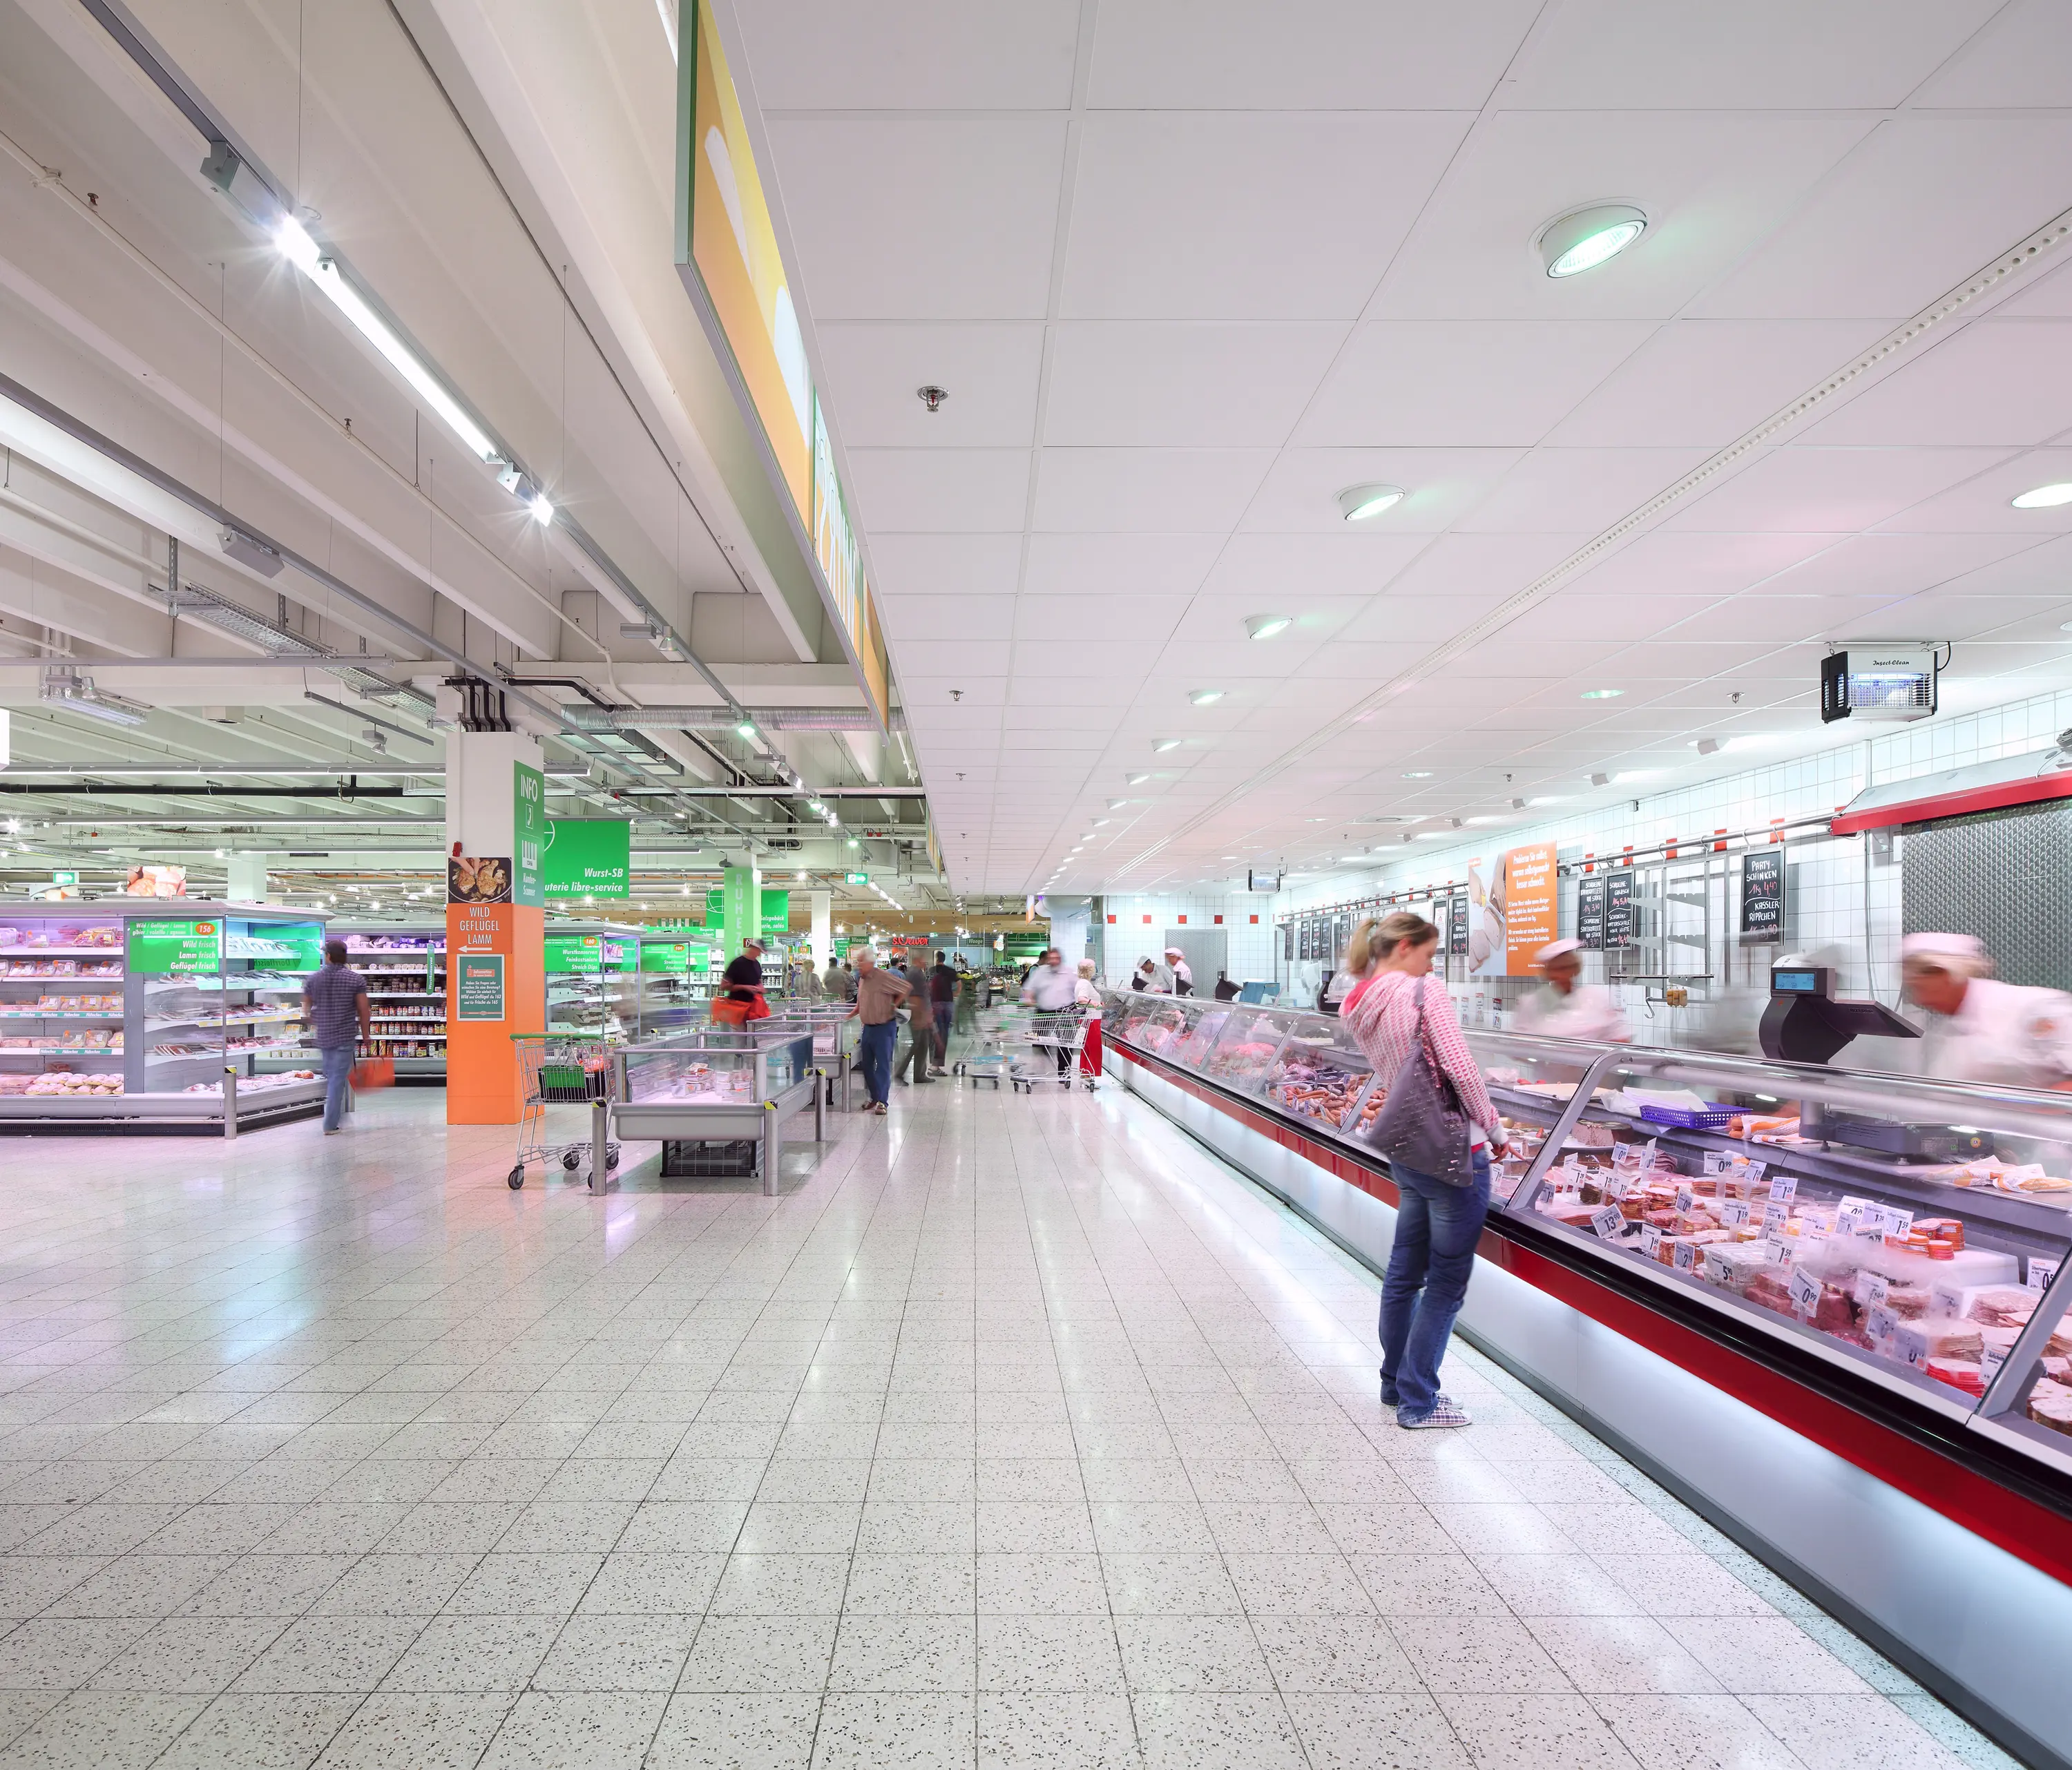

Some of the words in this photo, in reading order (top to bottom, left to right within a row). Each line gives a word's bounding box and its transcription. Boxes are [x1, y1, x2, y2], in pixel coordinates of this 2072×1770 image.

[521, 774, 538, 802] INFO
[1752, 860, 1774, 872] PARTY-
[584, 868, 623, 878] Wurst-SB
[571, 882, 623, 892] libre-service
[470, 907, 490, 917] WILD
[460, 918, 499, 931] GEFLÜGEL
[468, 934, 492, 945] LAMM
[171, 962, 198, 971] Geflügel
